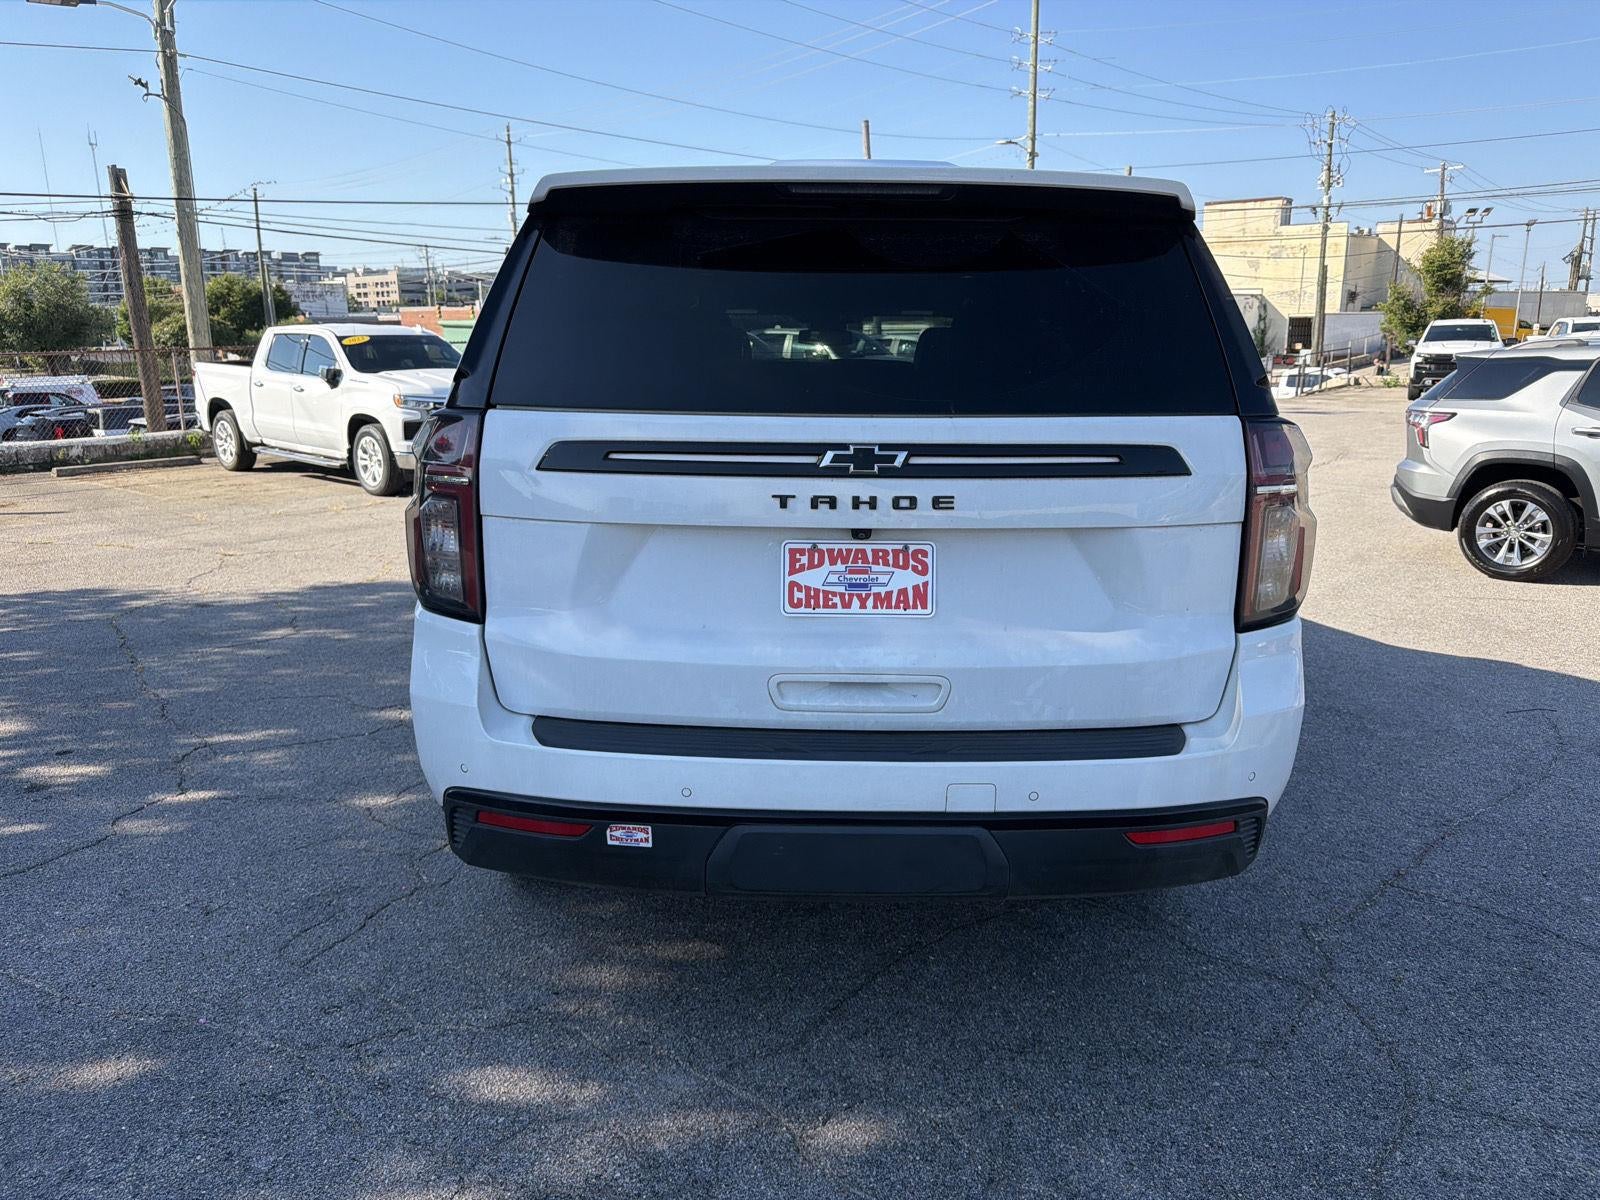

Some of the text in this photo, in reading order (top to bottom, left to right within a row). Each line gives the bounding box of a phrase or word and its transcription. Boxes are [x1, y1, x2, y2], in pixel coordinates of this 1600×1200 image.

[771, 494, 955, 510] TAHOE
[787, 547, 930, 577] EDWARDS
[837, 575, 879, 583] Chevrolet
[787, 580, 929, 610] CHEVYMAN
[609, 825, 650, 835] EDWARDS
[609, 834, 650, 843] CHEVYMAN
